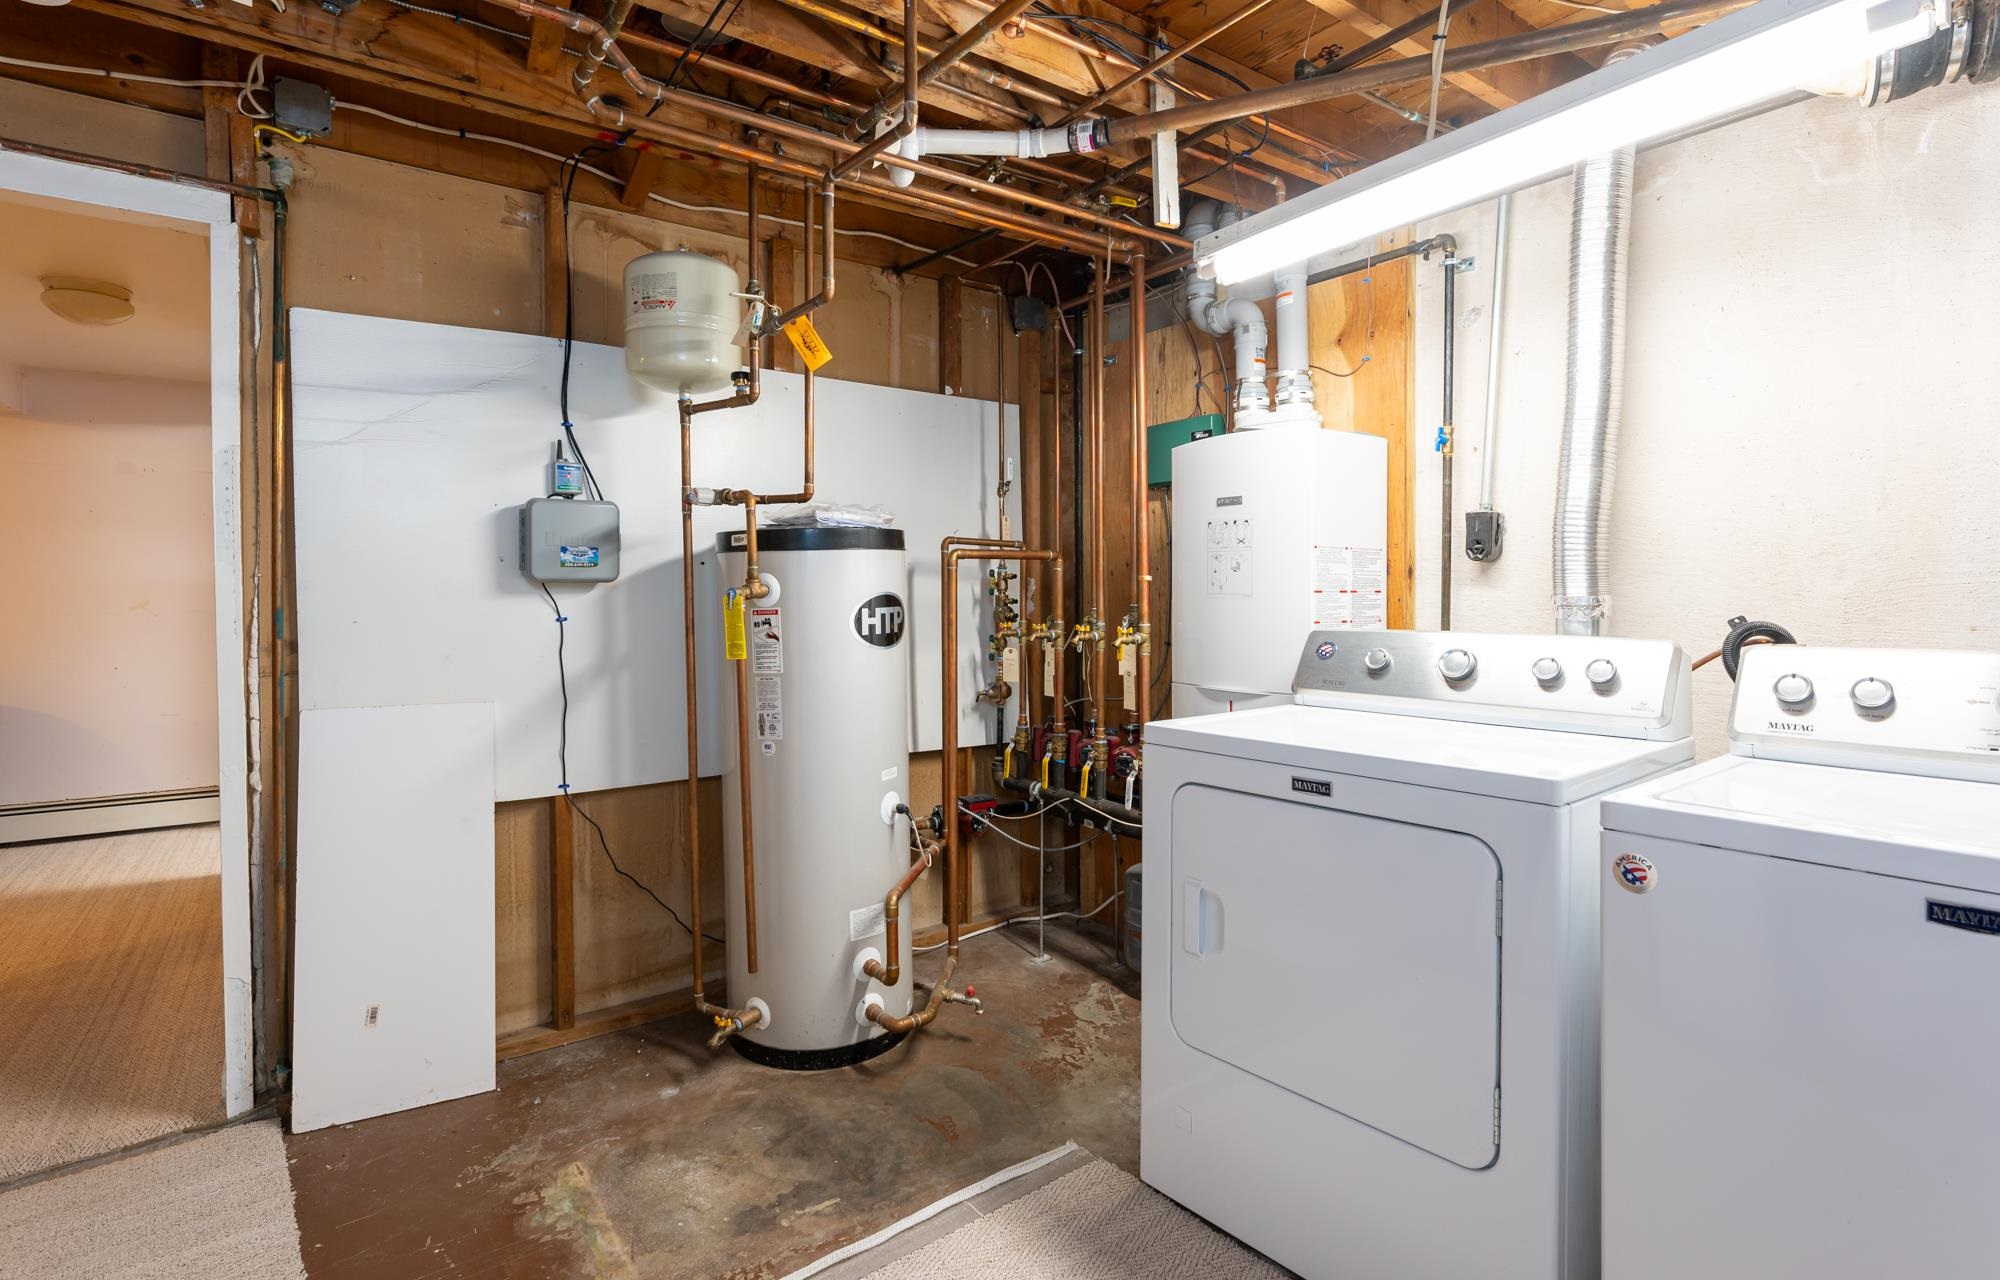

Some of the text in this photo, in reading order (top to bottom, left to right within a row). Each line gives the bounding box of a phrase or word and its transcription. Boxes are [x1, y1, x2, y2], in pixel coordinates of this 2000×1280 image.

[861, 606, 903, 636] HTP
[1767, 722, 1814, 732] MAYTAG
[1293, 780, 1329, 793] MAYTAG
[1615, 854, 1652, 870] AMERICA
